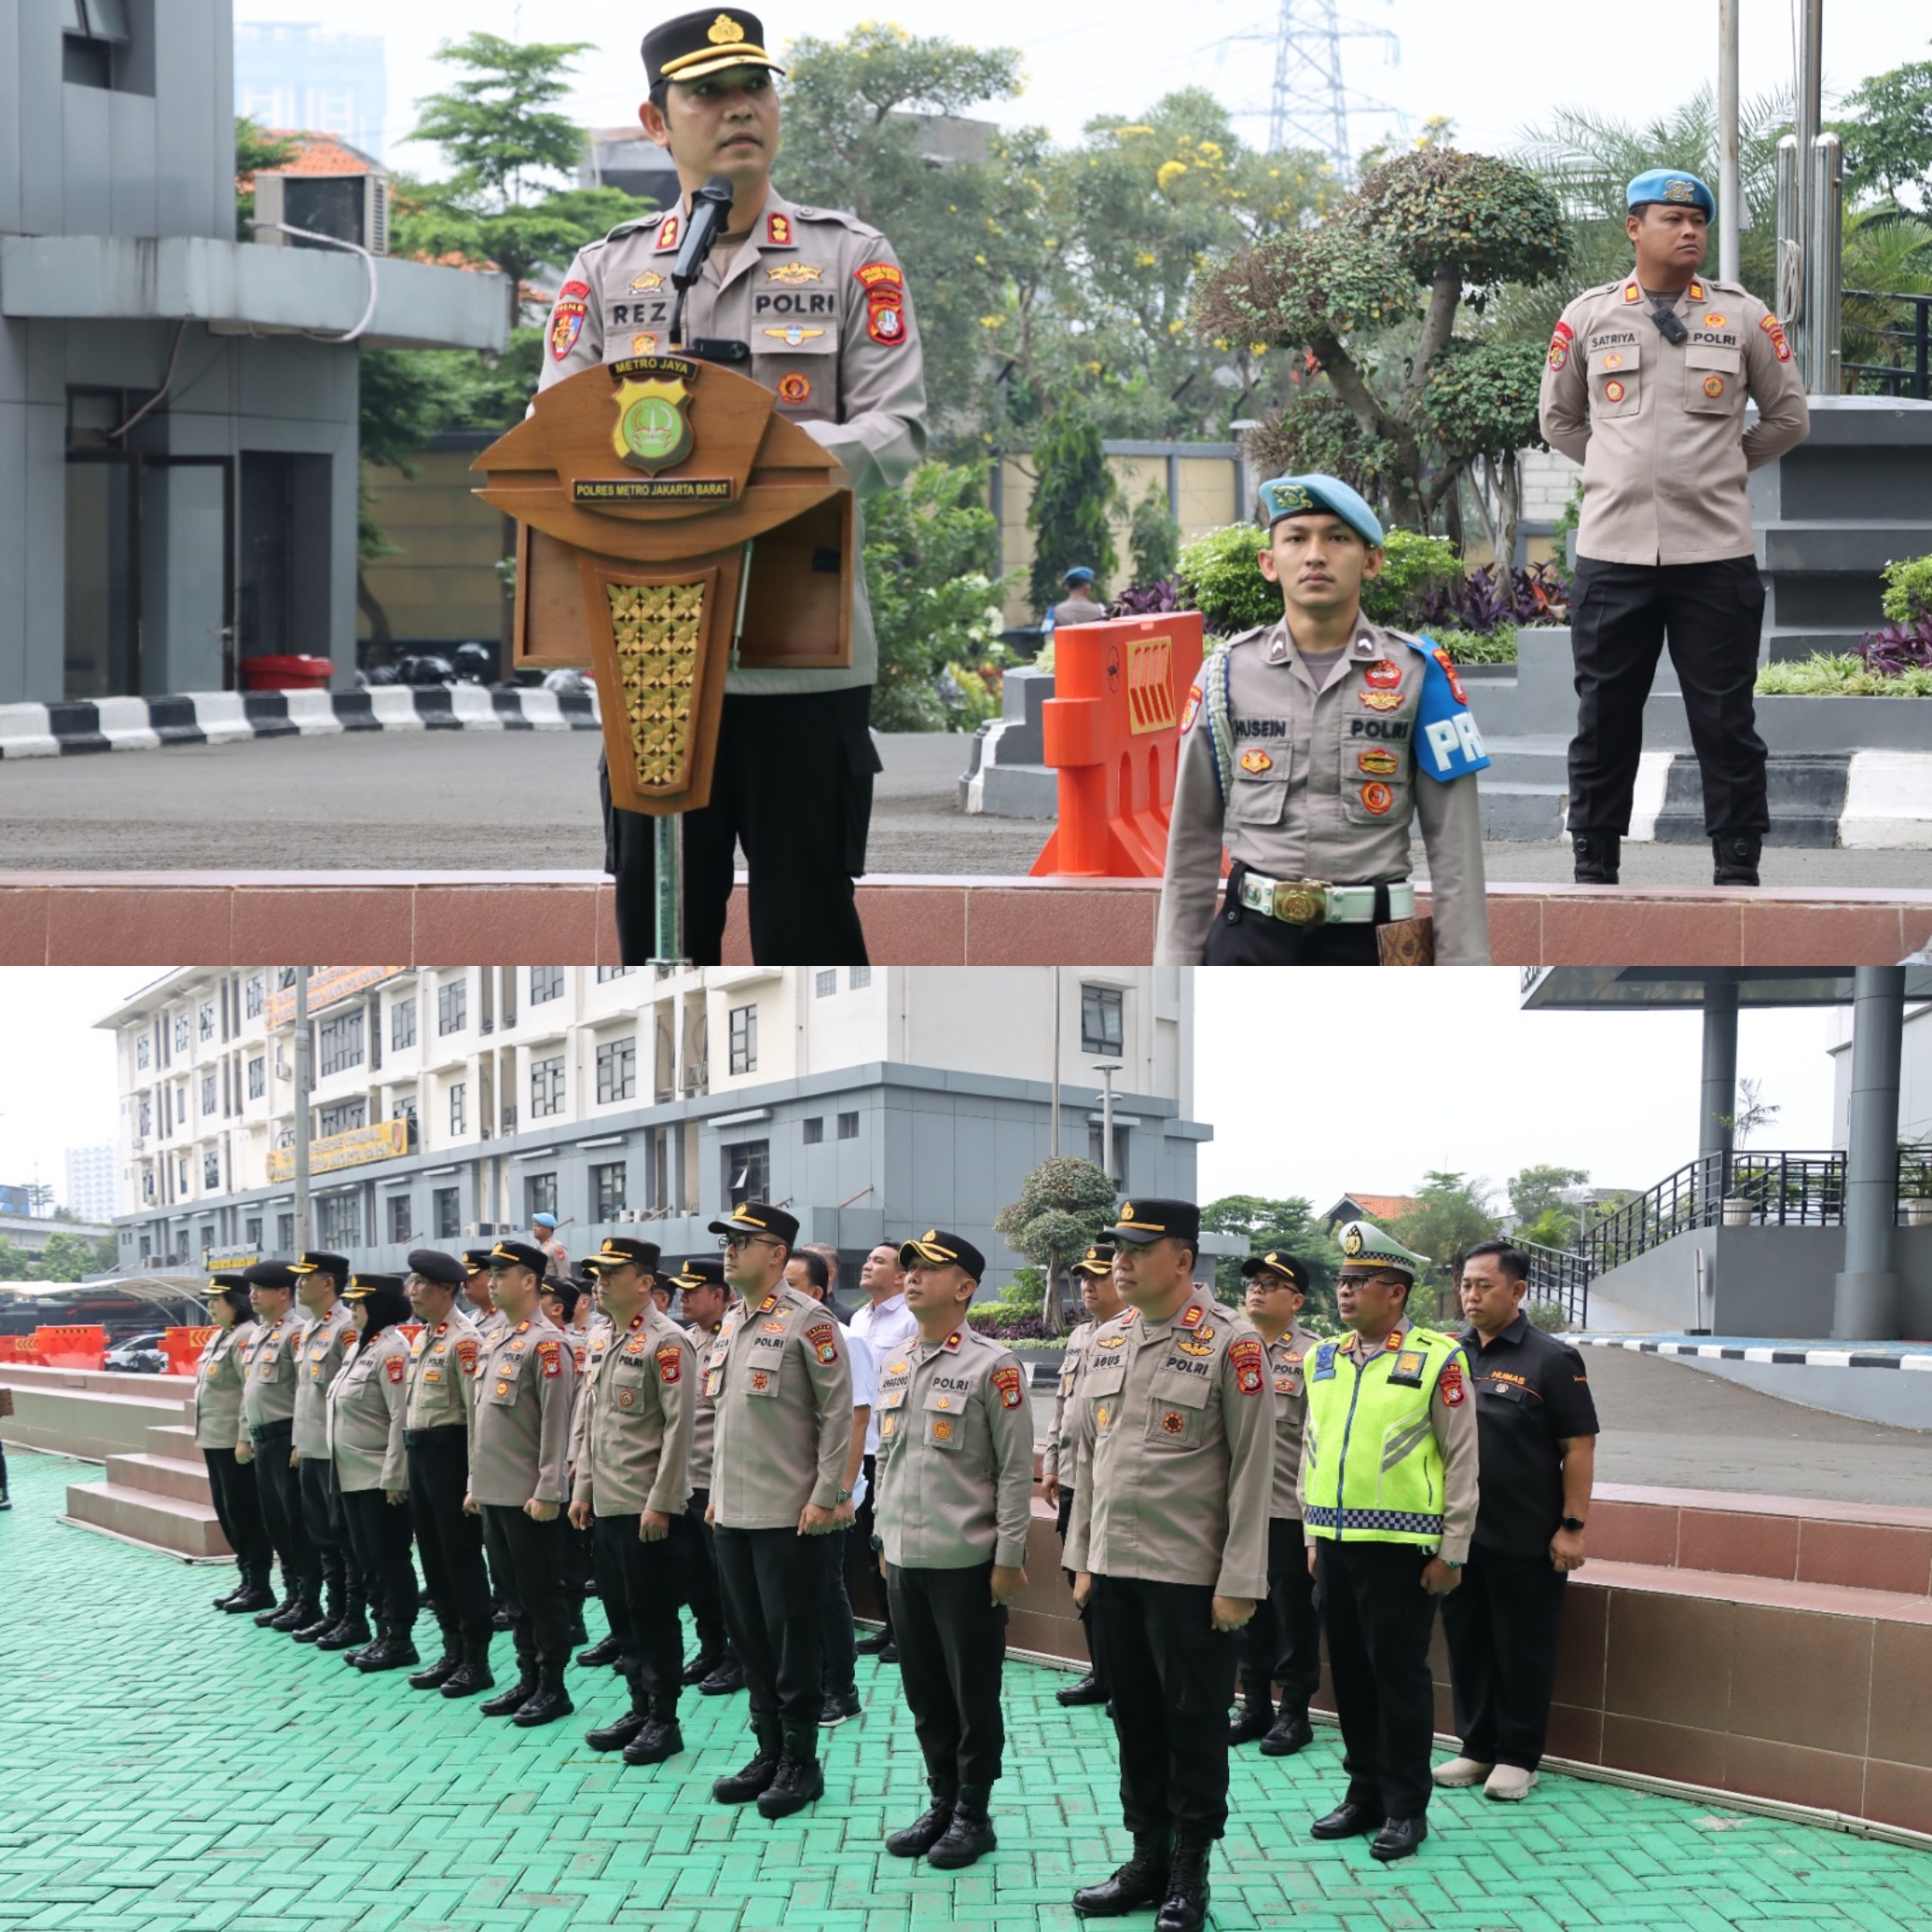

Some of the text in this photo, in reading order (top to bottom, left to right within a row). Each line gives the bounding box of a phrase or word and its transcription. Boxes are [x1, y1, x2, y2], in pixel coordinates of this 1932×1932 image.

[756, 293, 834, 313] POLRI
[1592, 333, 1635, 348] SATRIYA
[1693, 333, 1736, 345] POLRI
[614, 359, 689, 374] METRO JAYA
[576, 483, 728, 496] POLRES METRO JAKARTA BARAT
[1234, 718, 1286, 738] HUSEIN
[1351, 719, 1409, 740] POLRI
[754, 1337, 784, 1349] POLRI
[619, 1355, 642, 1368] POLRI
[1093, 1355, 1121, 1368] AGUS
[1166, 1357, 1209, 1377] POLRI
[1273, 1364, 1304, 1376] POLRI
[932, 1377, 970, 1391] POLRI
[1491, 1370, 1527, 1385] HUMAS
